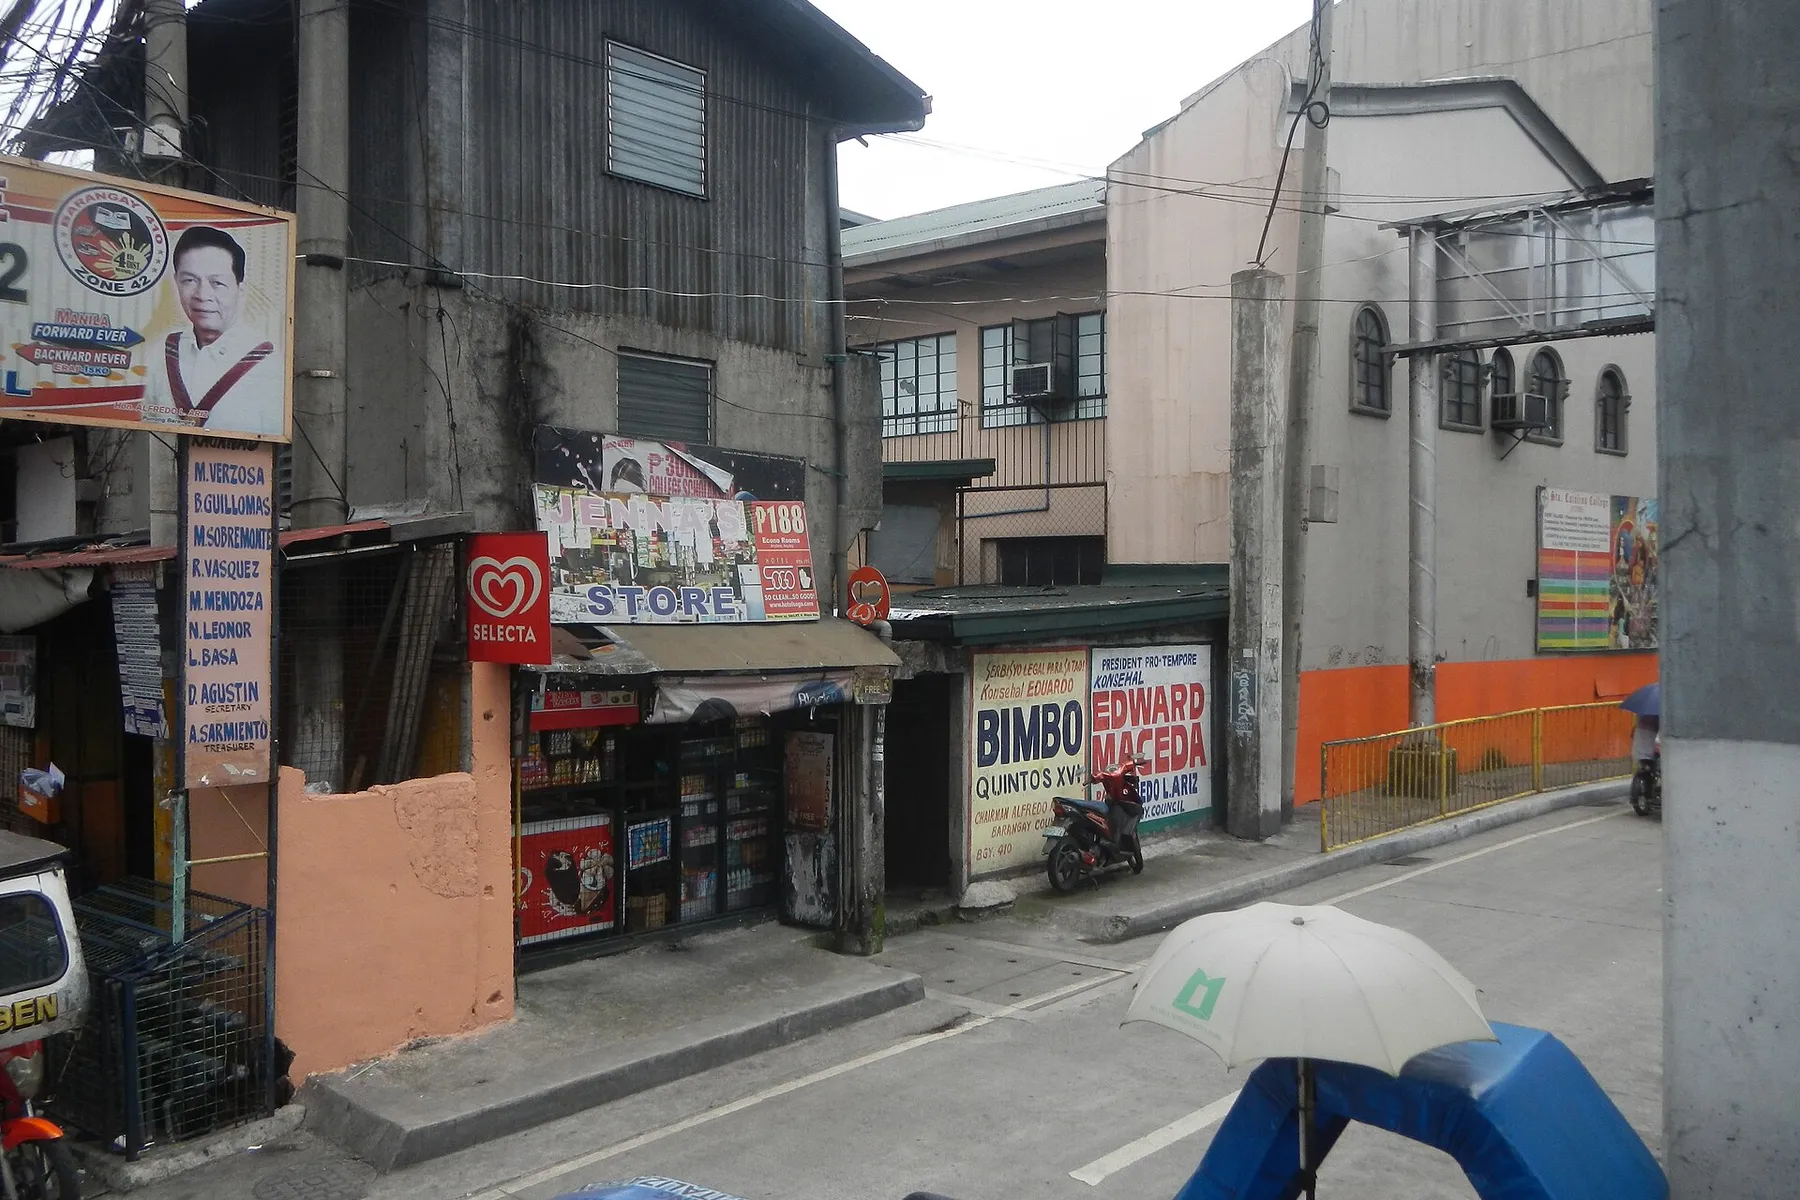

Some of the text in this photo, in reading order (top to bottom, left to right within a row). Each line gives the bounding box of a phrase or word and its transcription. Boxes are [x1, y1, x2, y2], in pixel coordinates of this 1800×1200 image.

[61, 191, 163, 245] BARANGAY 410
[75, 266, 152, 292] ZONE 42
[34, 325, 127, 342] FORWARD EVER
[34, 347, 127, 366] BACKWARD NEVER
[113, 402, 135, 413] Hon.
[136, 404, 178, 416] ALFREDO
[188, 410, 209, 419] ARIZ
[194, 461, 265, 485] M.VERZOSA
[550, 494, 742, 541] JENNA'S
[192, 557, 260, 581] R.VASQUEZ
[189, 590, 264, 612] M.MENDOZA
[586, 587, 738, 616] STORE
[189, 621, 252, 640] N.LEONOR
[473, 623, 537, 643] SELECTA
[188, 647, 239, 667] L.BASA
[1102, 657, 1143, 671] PRESIDENT
[986, 661, 1023, 682] SERBISYO
[1024, 662, 1046, 675] LEGAL
[1093, 671, 1145, 692] KONSEHAL
[200, 681, 260, 705] AGUSTIN
[864, 686, 881, 694] FREE
[980, 678, 1074, 701] Konsehal EDUARDO
[204, 703, 252, 714] SECRETARY
[1092, 682, 1205, 733] EDWARD
[188, 719, 268, 744] A.SARMIENTO
[977, 699, 1083, 769] BIMBO
[203, 742, 255, 753] TREASURER
[1092, 722, 1207, 777] MACEDA
[976, 767, 1052, 800] QUINTOS
[974, 807, 1010, 825] CHAIRMAN
[1012, 801, 1048, 819] ALFREDO
[991, 820, 1032, 839] BARANGAY
[976, 843, 1013, 861] BGY. 410
